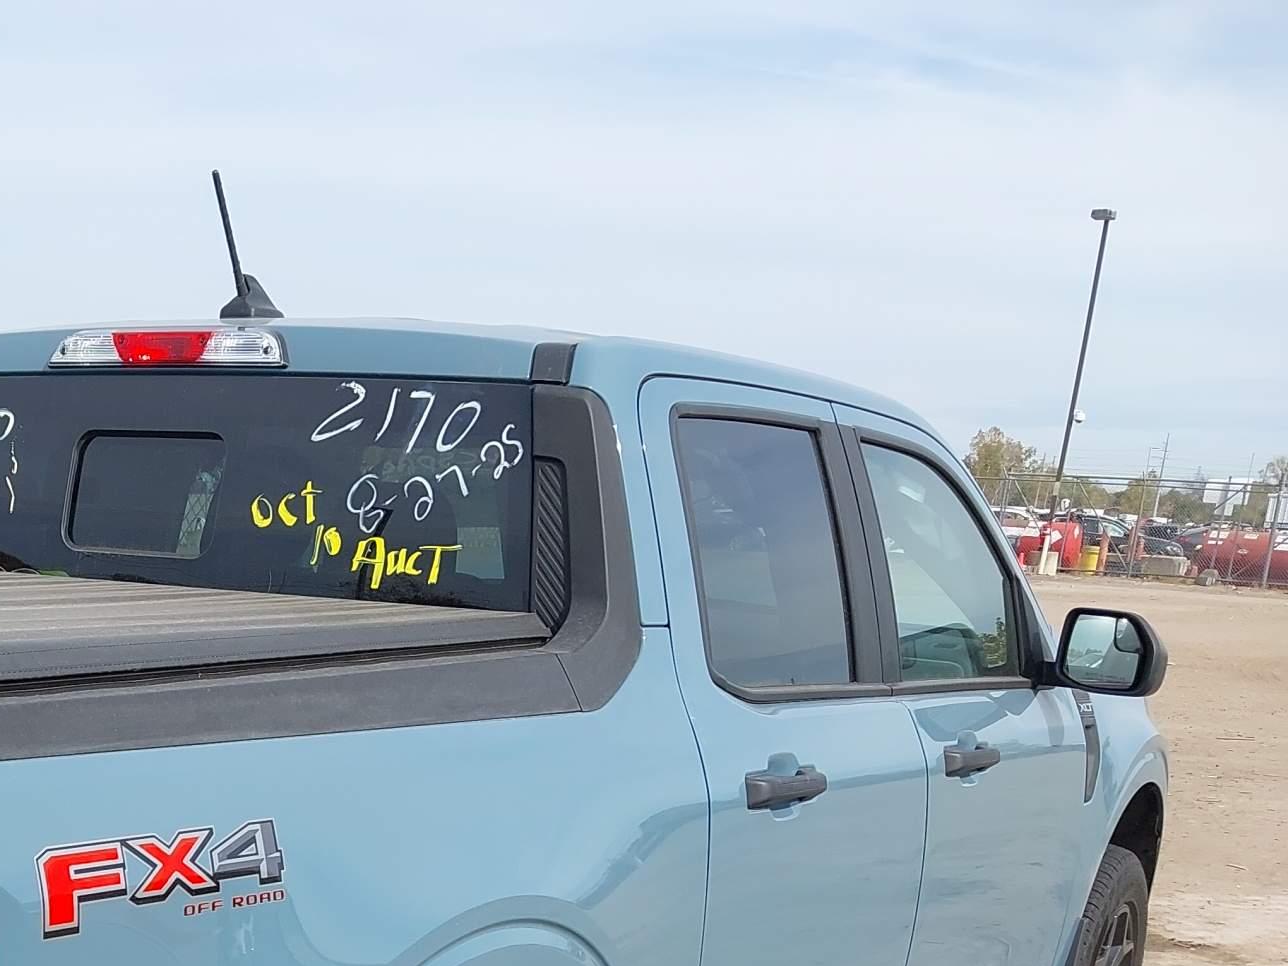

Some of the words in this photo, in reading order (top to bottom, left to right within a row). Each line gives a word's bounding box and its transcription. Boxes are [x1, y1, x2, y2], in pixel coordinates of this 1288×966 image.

[310, 380, 482, 454] 2170
[33, 817, 286, 941] FX4
[183, 899, 225, 917] OFF
[232, 889, 286, 909] ROAD
